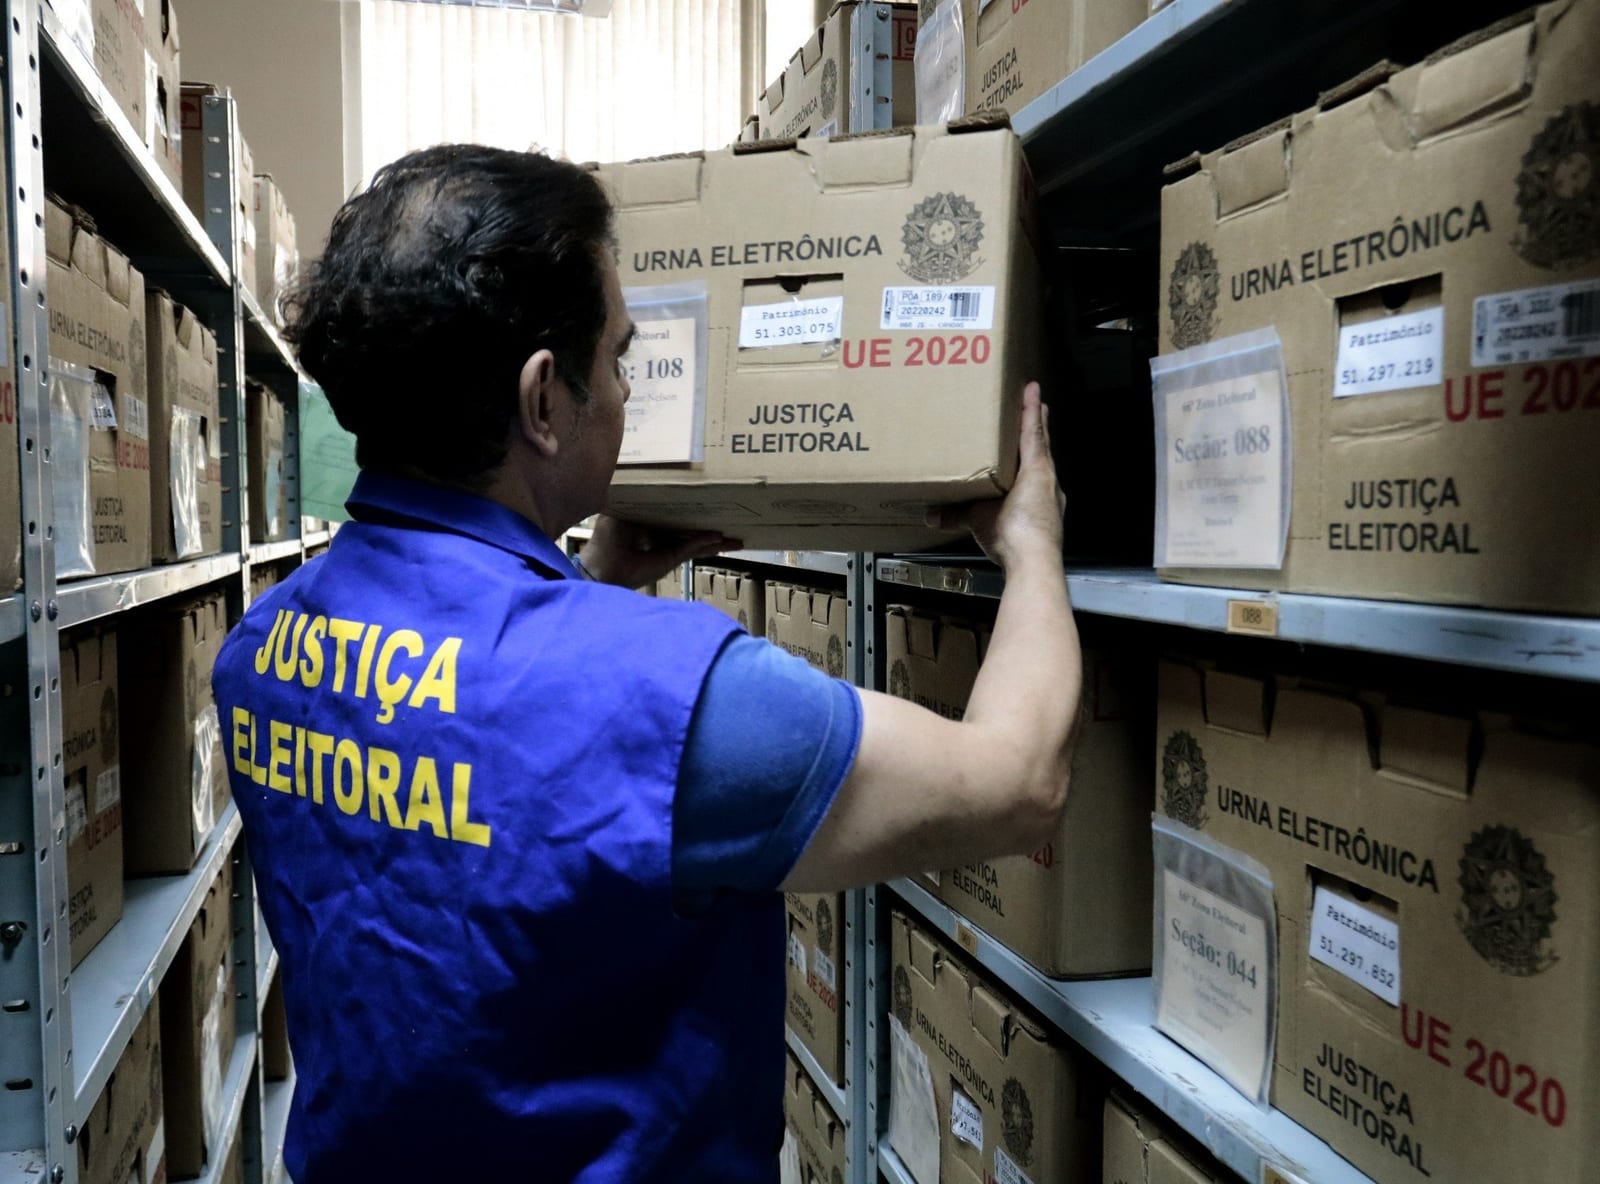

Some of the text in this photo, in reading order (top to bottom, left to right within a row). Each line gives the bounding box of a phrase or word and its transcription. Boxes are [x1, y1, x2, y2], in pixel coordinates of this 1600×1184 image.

[977, 71, 1024, 110] EITORAL
[981, 47, 1017, 93] JUSTIÇA
[633, 233, 883, 272] URNA ELETRÔNICA
[1230, 200, 1493, 302] URNA ELETRÔNICA
[754, 322, 835, 339] 51.303.075
[762, 307, 829, 320] Patrimônio
[1350, 322, 1433, 348] Patrimônio
[645, 357, 684, 379] 108
[842, 334, 991, 369] UE 2020
[1341, 357, 1434, 385] 51.297.219
[748, 403, 855, 428] JUSTIÇA
[1444, 371, 1505, 423] UE
[730, 432, 870, 455] ELEITORAL
[1234, 424, 1271, 456] 088
[1344, 477, 1460, 515] JUSTIÇA
[1328, 522, 1480, 555] ELEITORAL
[254, 608, 463, 725] JUSTIÇA
[232, 705, 492, 848] ELEITORAL
[1216, 784, 1441, 894] URNA ELETRÔNICA
[953, 870, 1005, 918] ELEITORAL
[1326, 904, 1397, 951] Patrimônio
[1171, 917, 1257, 989] Seção: 044
[1320, 935, 1395, 989] 51.297.852
[916, 1009, 937, 1046] URNA
[938, 1035, 996, 1110] ELETRÔNICA
[1400, 1003, 1567, 1129] UE 2020
[1316, 1042, 1415, 1126] JUSTIÇA
[1302, 1068, 1432, 1179] ELEITORAL
